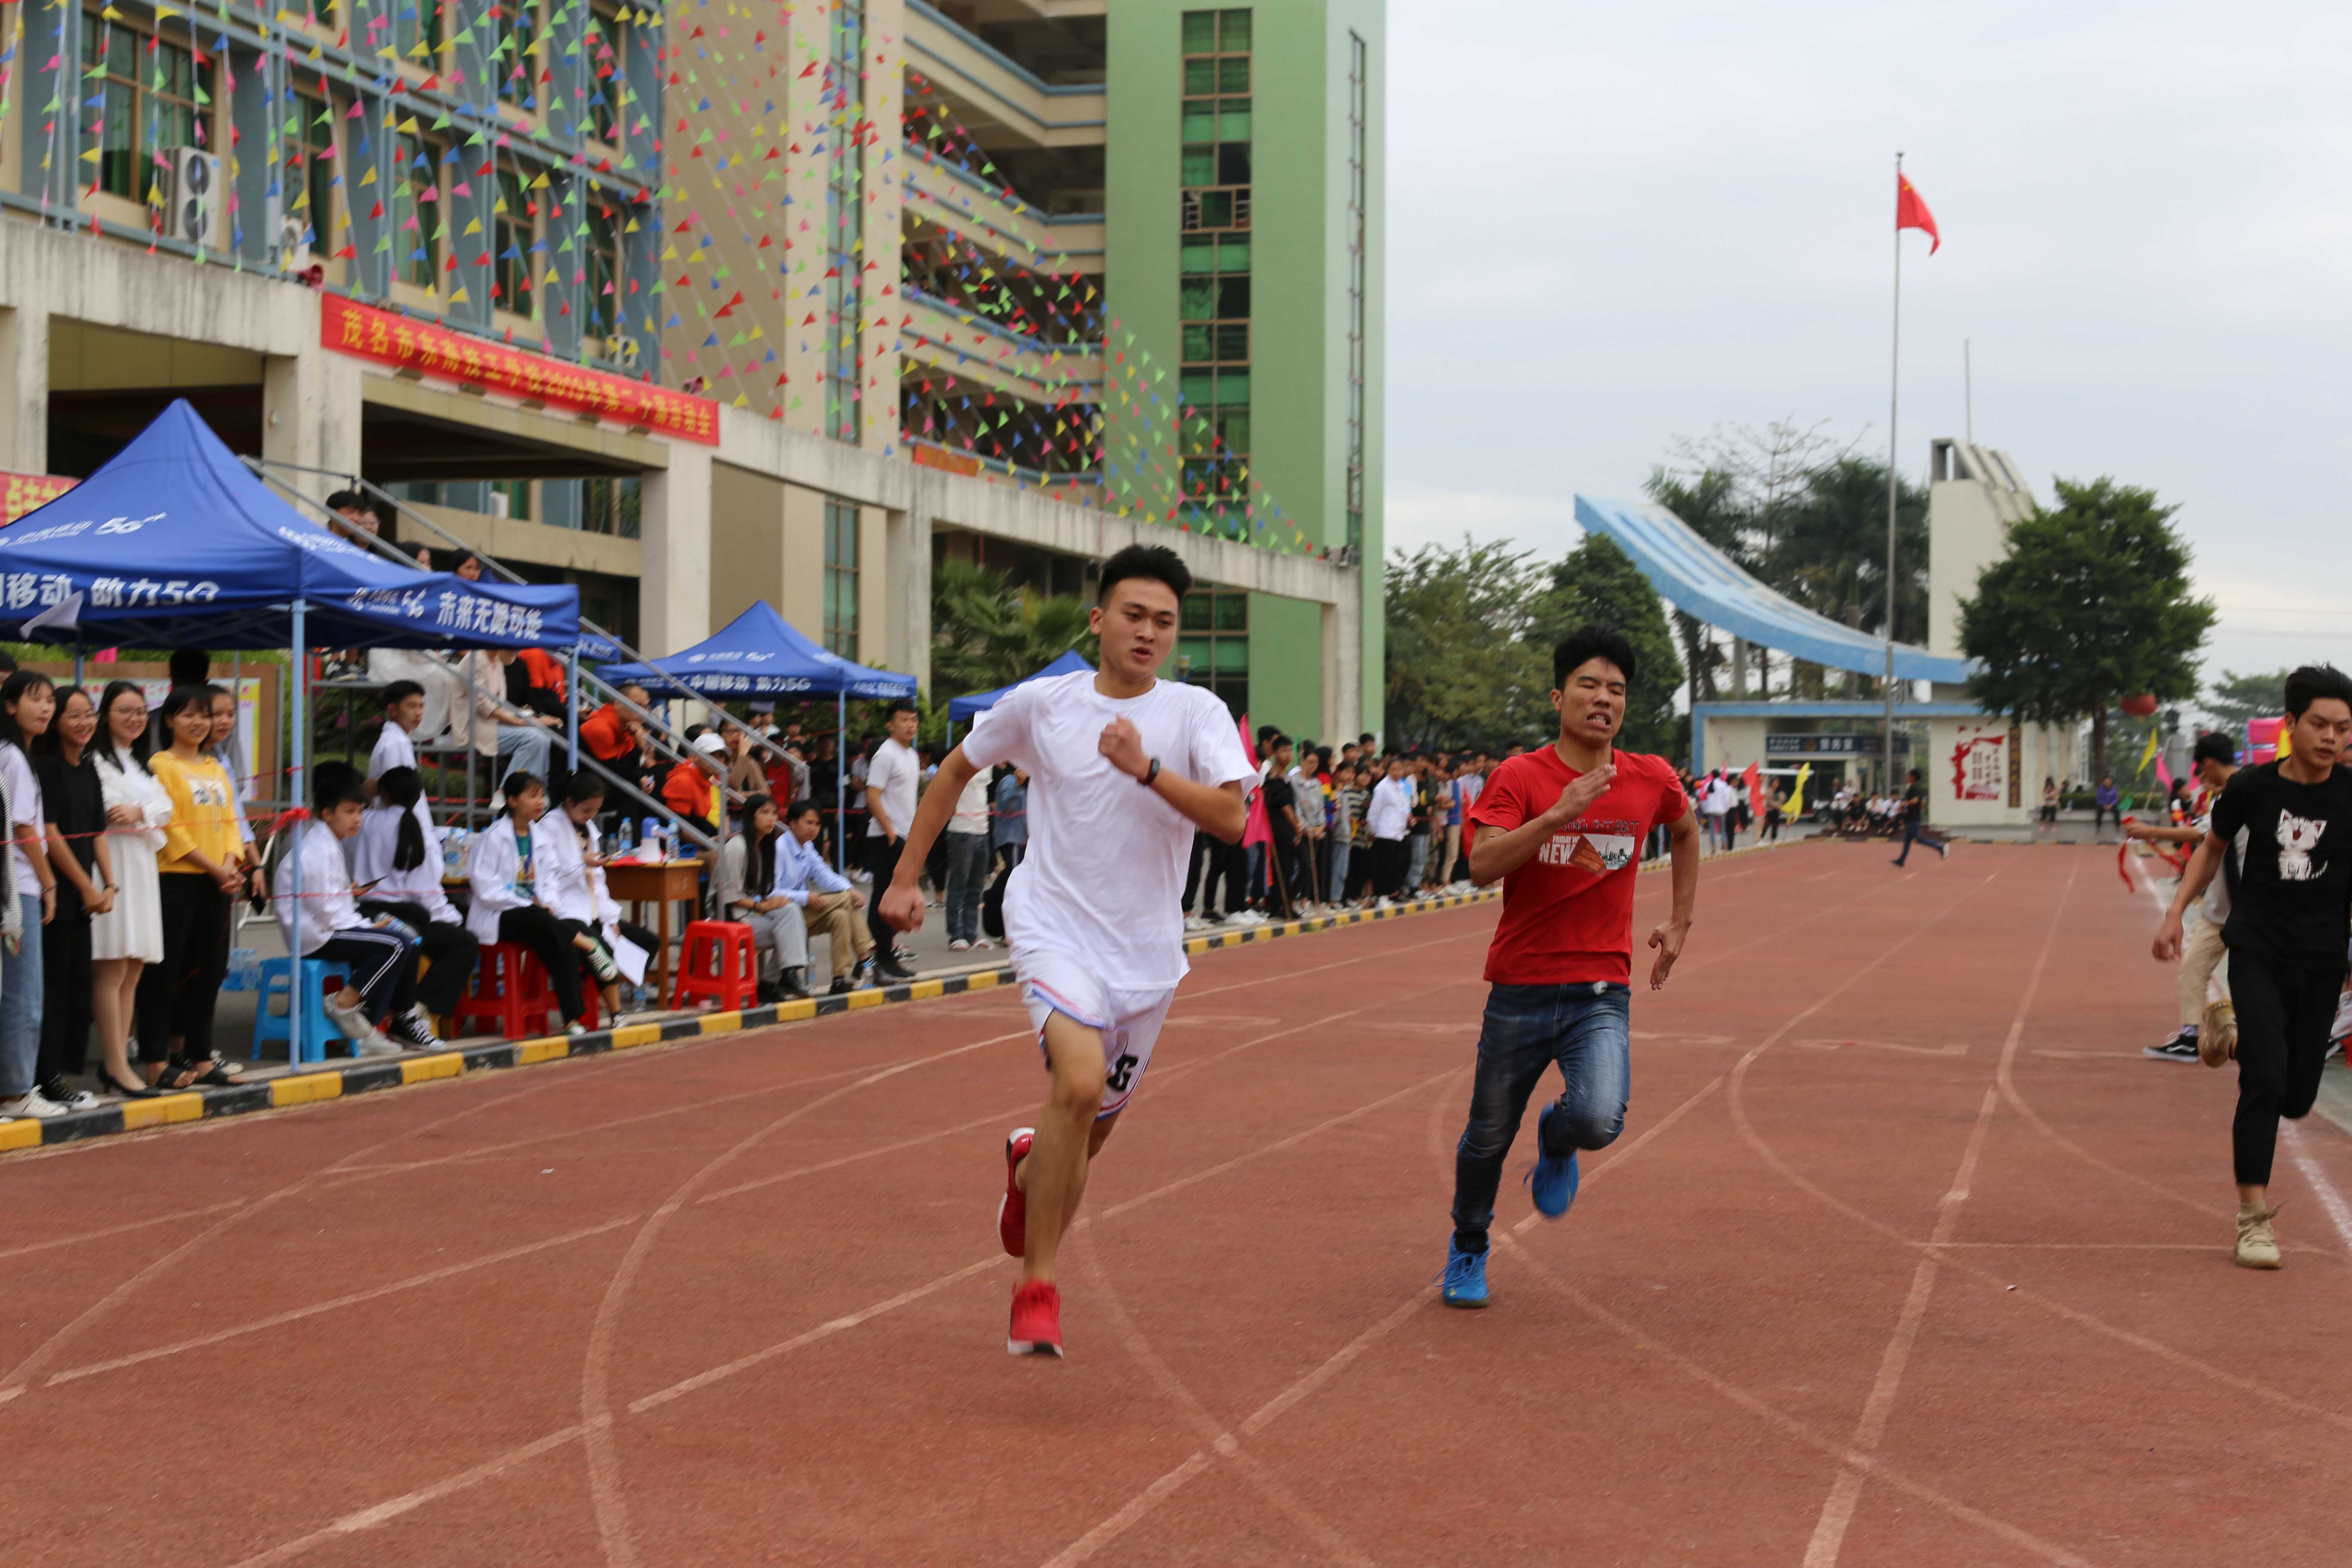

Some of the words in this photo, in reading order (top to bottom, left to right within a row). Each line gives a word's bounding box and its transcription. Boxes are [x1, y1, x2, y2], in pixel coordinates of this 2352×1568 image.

[0, 572, 74, 609] 移动
[689, 674, 750, 691] 中国移动
[755, 676, 812, 691] 助力5G
[1593, 819, 1639, 835] START
